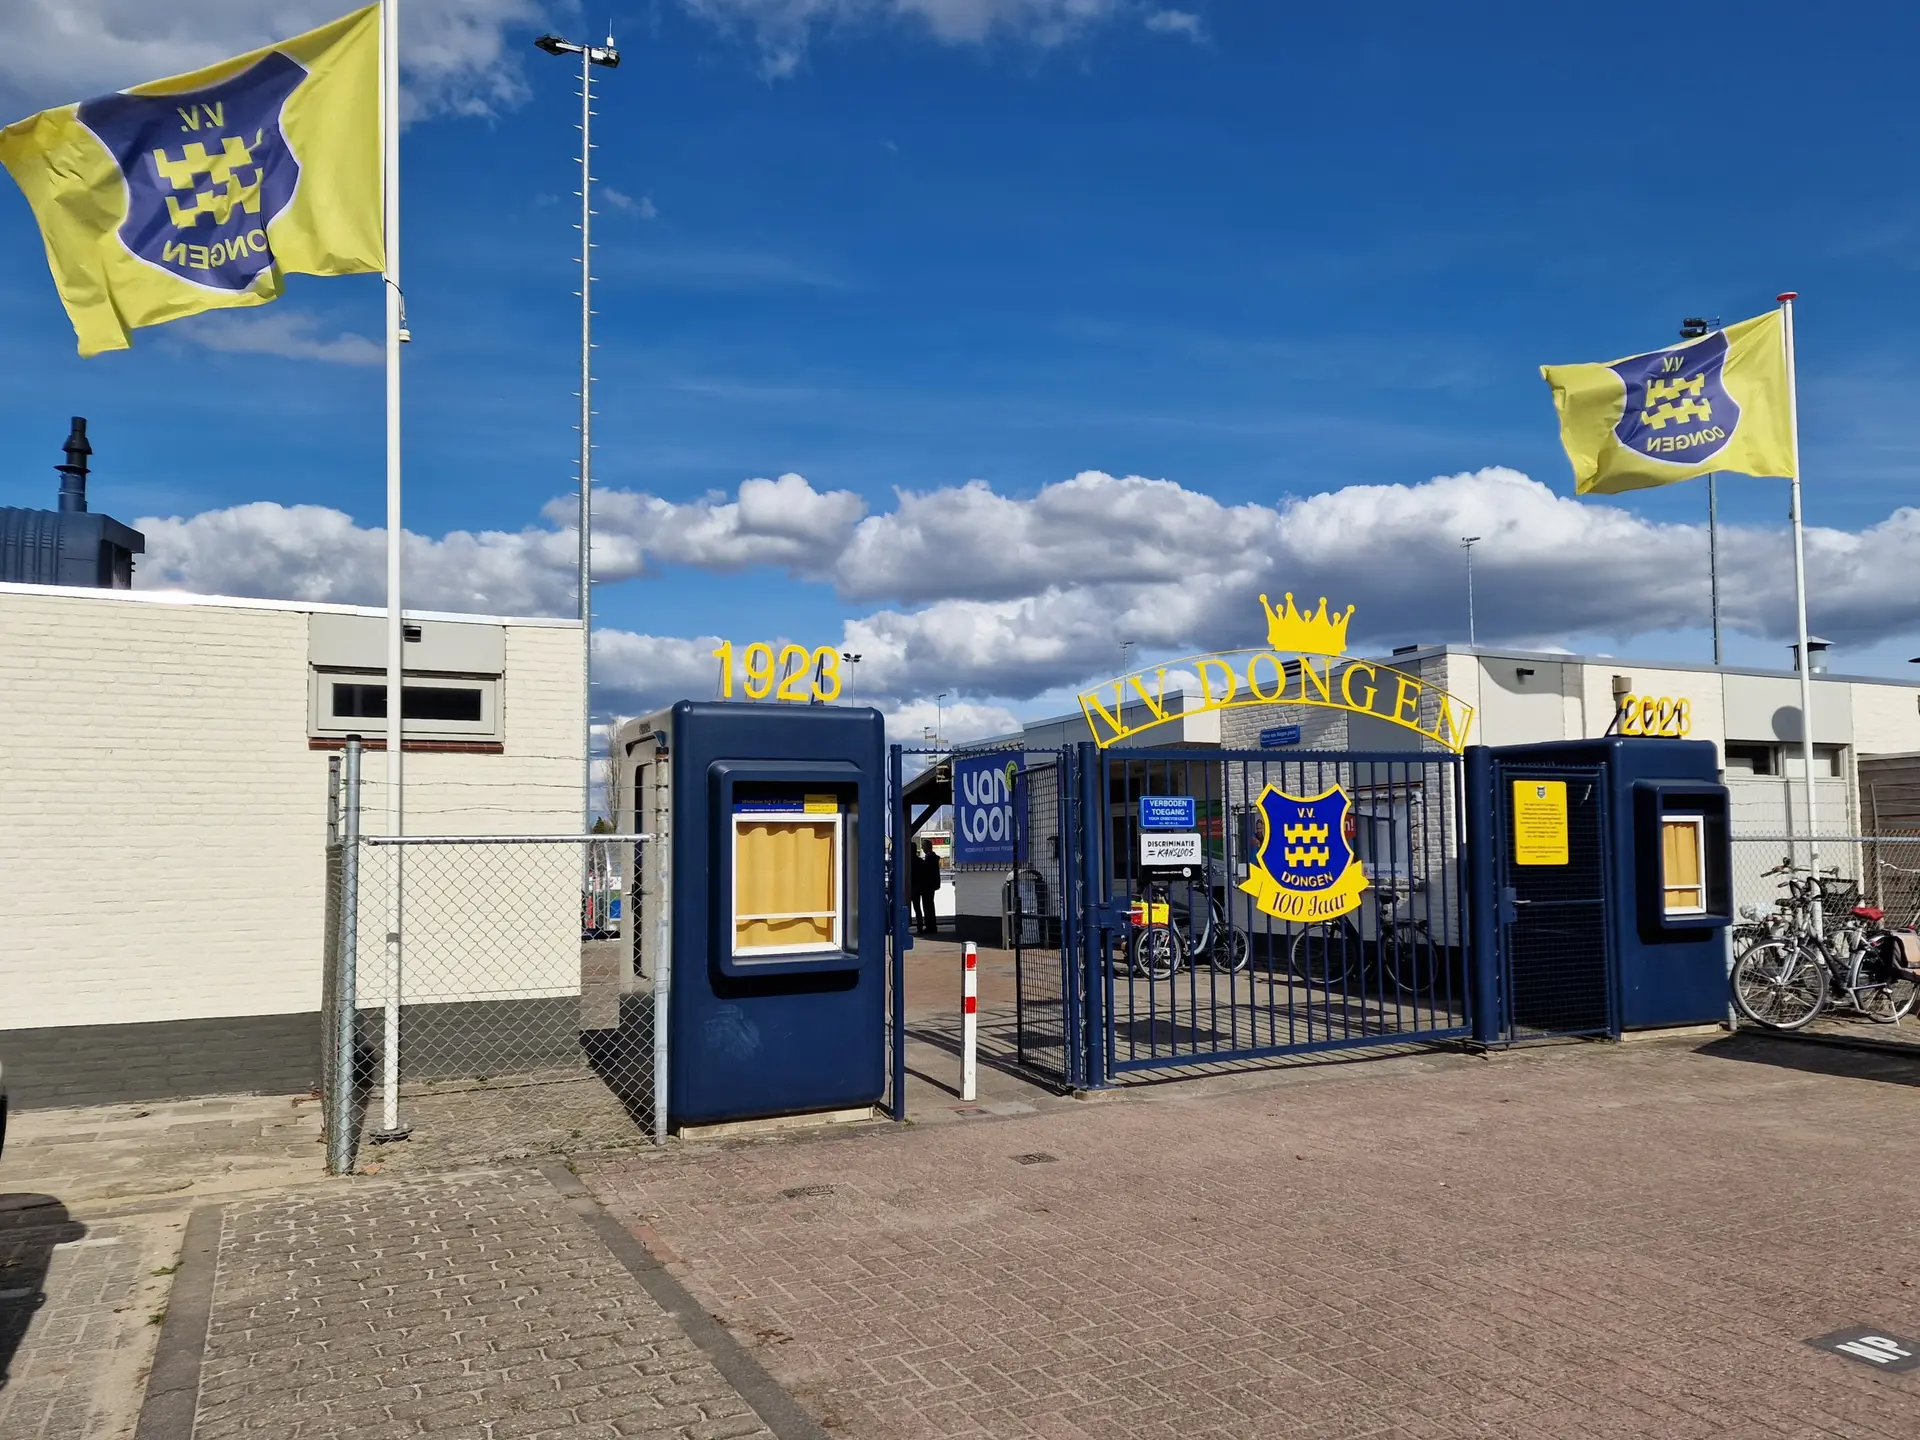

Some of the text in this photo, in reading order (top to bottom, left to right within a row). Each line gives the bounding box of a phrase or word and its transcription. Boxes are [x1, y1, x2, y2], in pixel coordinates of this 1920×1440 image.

[712, 640, 843, 702] 1923
[1194, 652, 1474, 752] DONGEN
[1621, 692, 1692, 736] 2023
[1152, 808, 1185, 816] TOEGANG
[1297, 807, 1316, 818] V.V.
[1147, 840, 1195, 848] DISCRIMINATIE
[1157, 847, 1194, 858] KANSLOOS
[1281, 871, 1334, 887] DONGEN
[1272, 891, 1348, 917] 100 Jaar
[1835, 1336, 1913, 1364] NP
